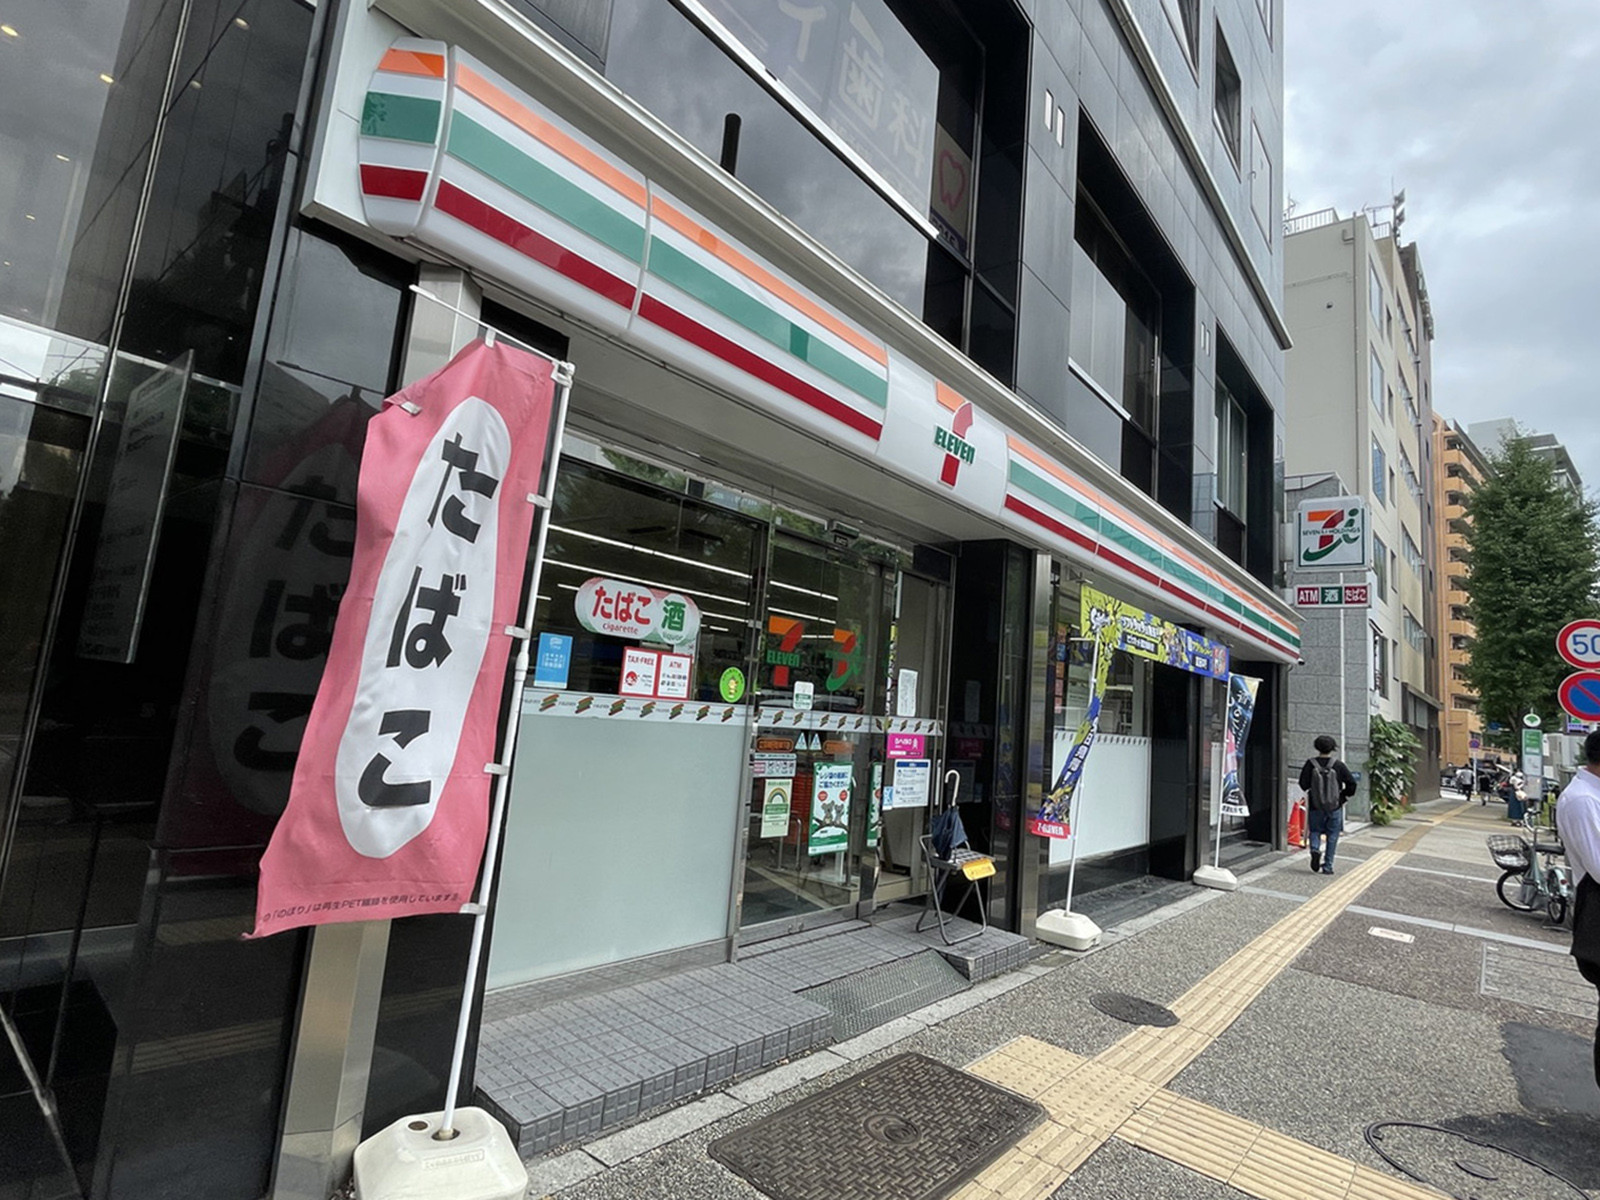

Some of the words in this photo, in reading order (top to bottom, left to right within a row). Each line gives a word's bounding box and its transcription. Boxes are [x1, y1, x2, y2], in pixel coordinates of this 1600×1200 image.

[934, 425, 976, 465] ELEVEN
[592, 586, 651, 625] たばこ
[661, 600, 686, 631] 酒
[1299, 590, 1318, 603] ATM
[1324, 589, 1339, 602] 酒
[1345, 588, 1367, 602] たばこ
[358, 432, 499, 809] たばこ
[668, 660, 683, 670] ATM
[766, 649, 800, 668] ELEVEN
